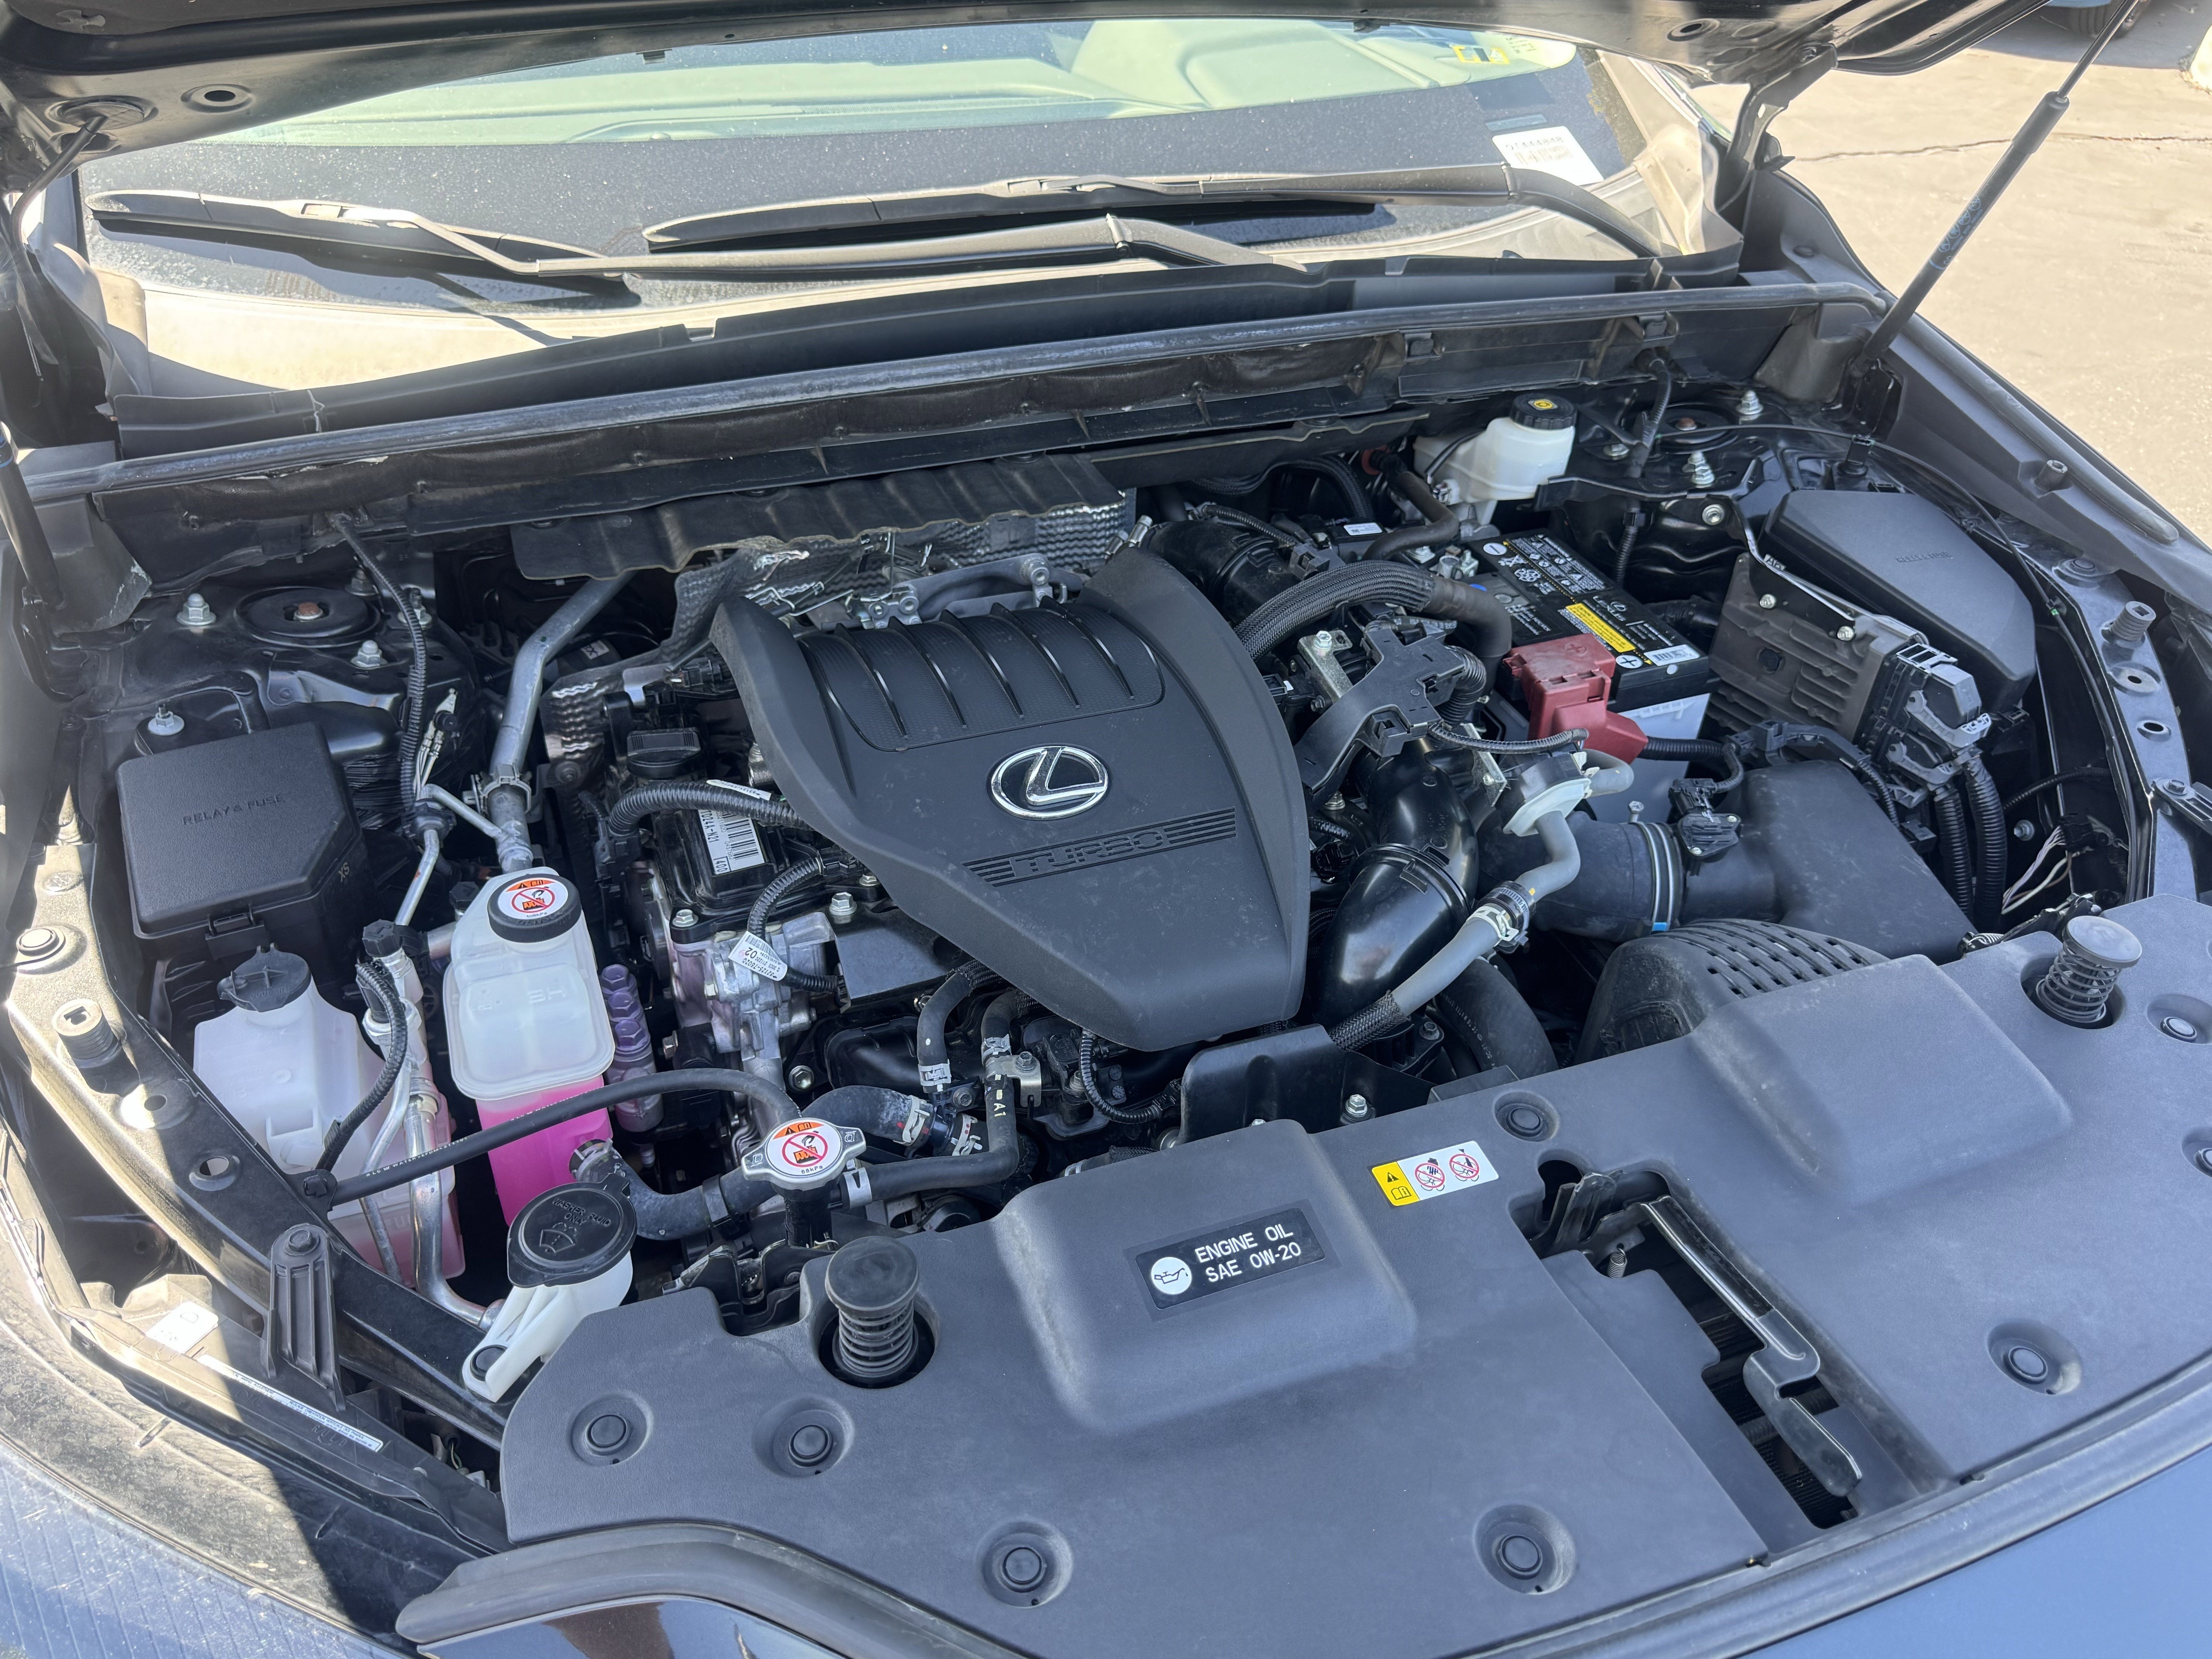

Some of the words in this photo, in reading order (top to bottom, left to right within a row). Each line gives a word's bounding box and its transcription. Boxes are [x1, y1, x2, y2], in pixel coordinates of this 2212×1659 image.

[1928, 551, 1952, 560] FUSE
[1593, 596, 1626, 622] LEXUS
[182, 805, 230, 825] RELAY
[247, 794, 286, 810] FUSE
[715, 860, 728, 872] 400
[1013, 830, 1164, 875] TURBO
[745, 947, 757, 959] 02
[552, 1197, 586, 1217] WASHER
[588, 1212, 611, 1227] FLUID
[564, 1213, 587, 1226] ONLY
[1195, 1232, 1259, 1264] ENGINE
[1264, 1223, 1294, 1242] OIL
[1206, 1259, 1242, 1283] SAE
[1249, 1241, 1302, 1269] 0W-20
